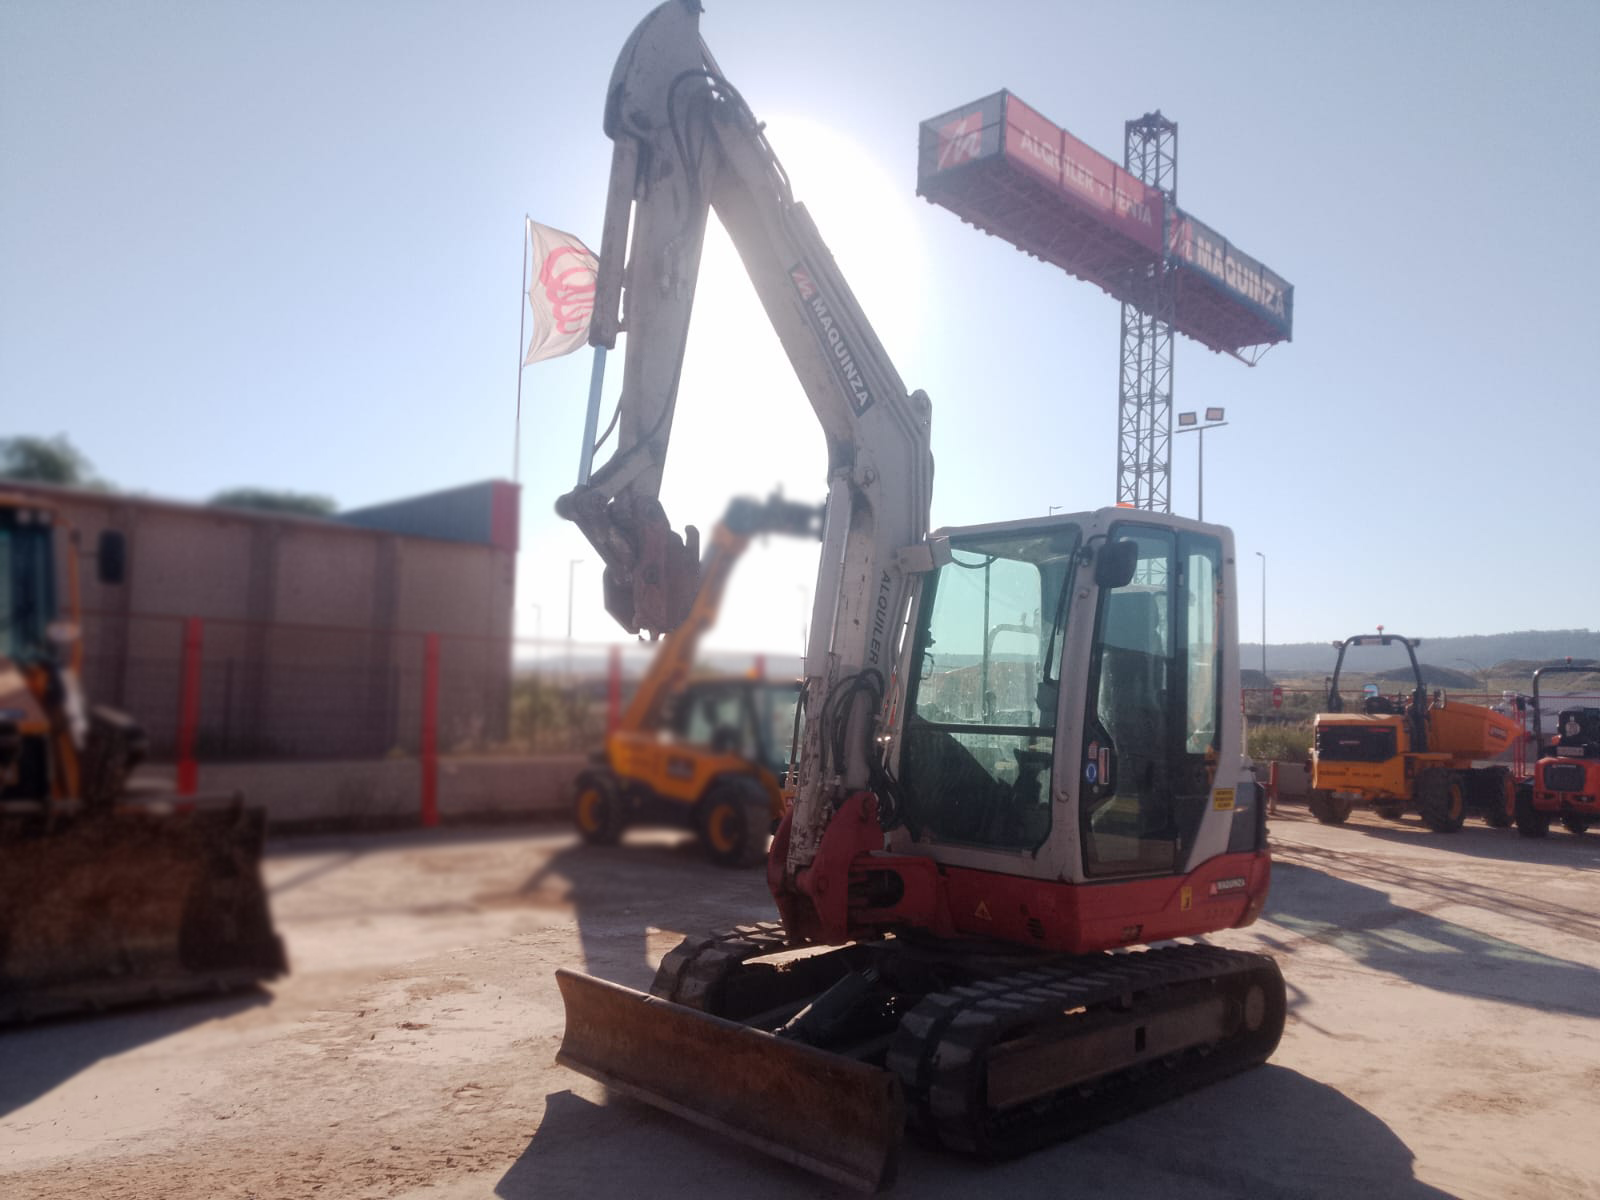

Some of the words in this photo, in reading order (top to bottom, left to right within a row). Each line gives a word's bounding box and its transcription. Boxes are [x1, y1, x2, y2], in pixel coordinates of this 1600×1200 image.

[1020, 129, 1094, 192] ALQUILER
[1197, 236, 1285, 319] MAQUINZA
[812, 298, 869, 407] MAQUINZA
[870, 570, 891, 664] ALQUILER
